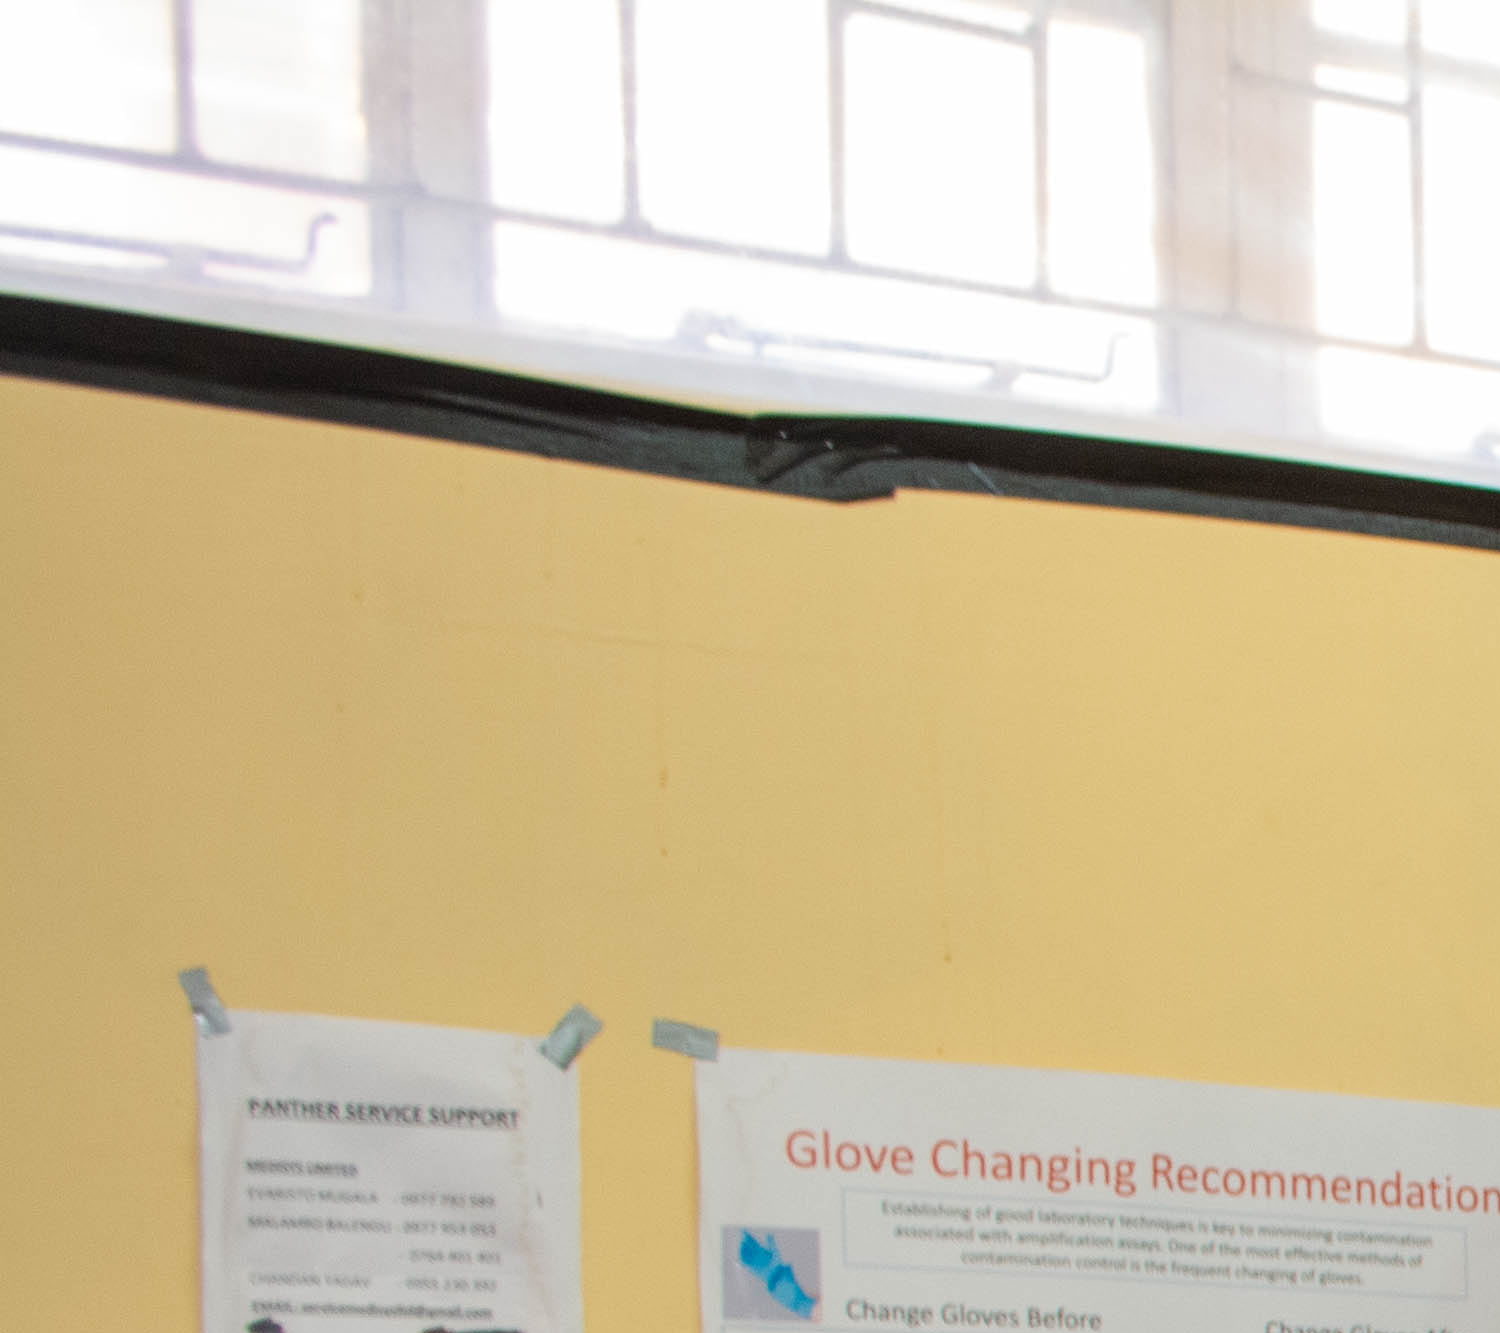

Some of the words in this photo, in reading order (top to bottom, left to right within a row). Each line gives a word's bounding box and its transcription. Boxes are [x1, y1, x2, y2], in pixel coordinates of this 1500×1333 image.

[249, 1098, 341, 1123] PANTHER
[346, 1102, 422, 1125] SERVICE
[428, 1104, 519, 1130] SUPPORT
[786, 1130, 914, 1175] Glove
[931, 1138, 1136, 1197] Changing
[882, 1201, 970, 1221] Establishing
[975, 1205, 991, 1220] of
[994, 1207, 1033, 1226] good
[1038, 1209, 1115, 1229] laboratory
[1119, 1214, 1194, 1235] techniques
[1212, 1220, 1236, 1238] key
[1239, 1223, 1253, 1236] to
[1337, 1228, 1433, 1248] contamination
[893, 1225, 973, 1242] associated
[979, 1228, 1013, 1244] with
[1016, 1230, 1113, 1251] amplification
[1168, 1238, 1197, 1254] One
[1201, 1240, 1217, 1256] of
[1219, 1242, 1242, 1257] the
[1246, 1246, 1280, 1260] most
[1284, 1245, 1345, 1263] effective
[1347, 1248, 1405, 1267] methods
[1408, 1253, 1423, 1268] of
[960, 1250, 1070, 1268] contamination
[1076, 1254, 1126, 1271] control
[1130, 1257, 1141, 1271] is
[1144, 1258, 1166, 1273] the
[1170, 1260, 1230, 1281] frequent
[1235, 1263, 1297, 1284] changing
[1301, 1268, 1316, 1284] of
[845, 1299, 934, 1328] Change
[941, 1302, 1020, 1329] Gloves
[1027, 1305, 1102, 1331] Before
